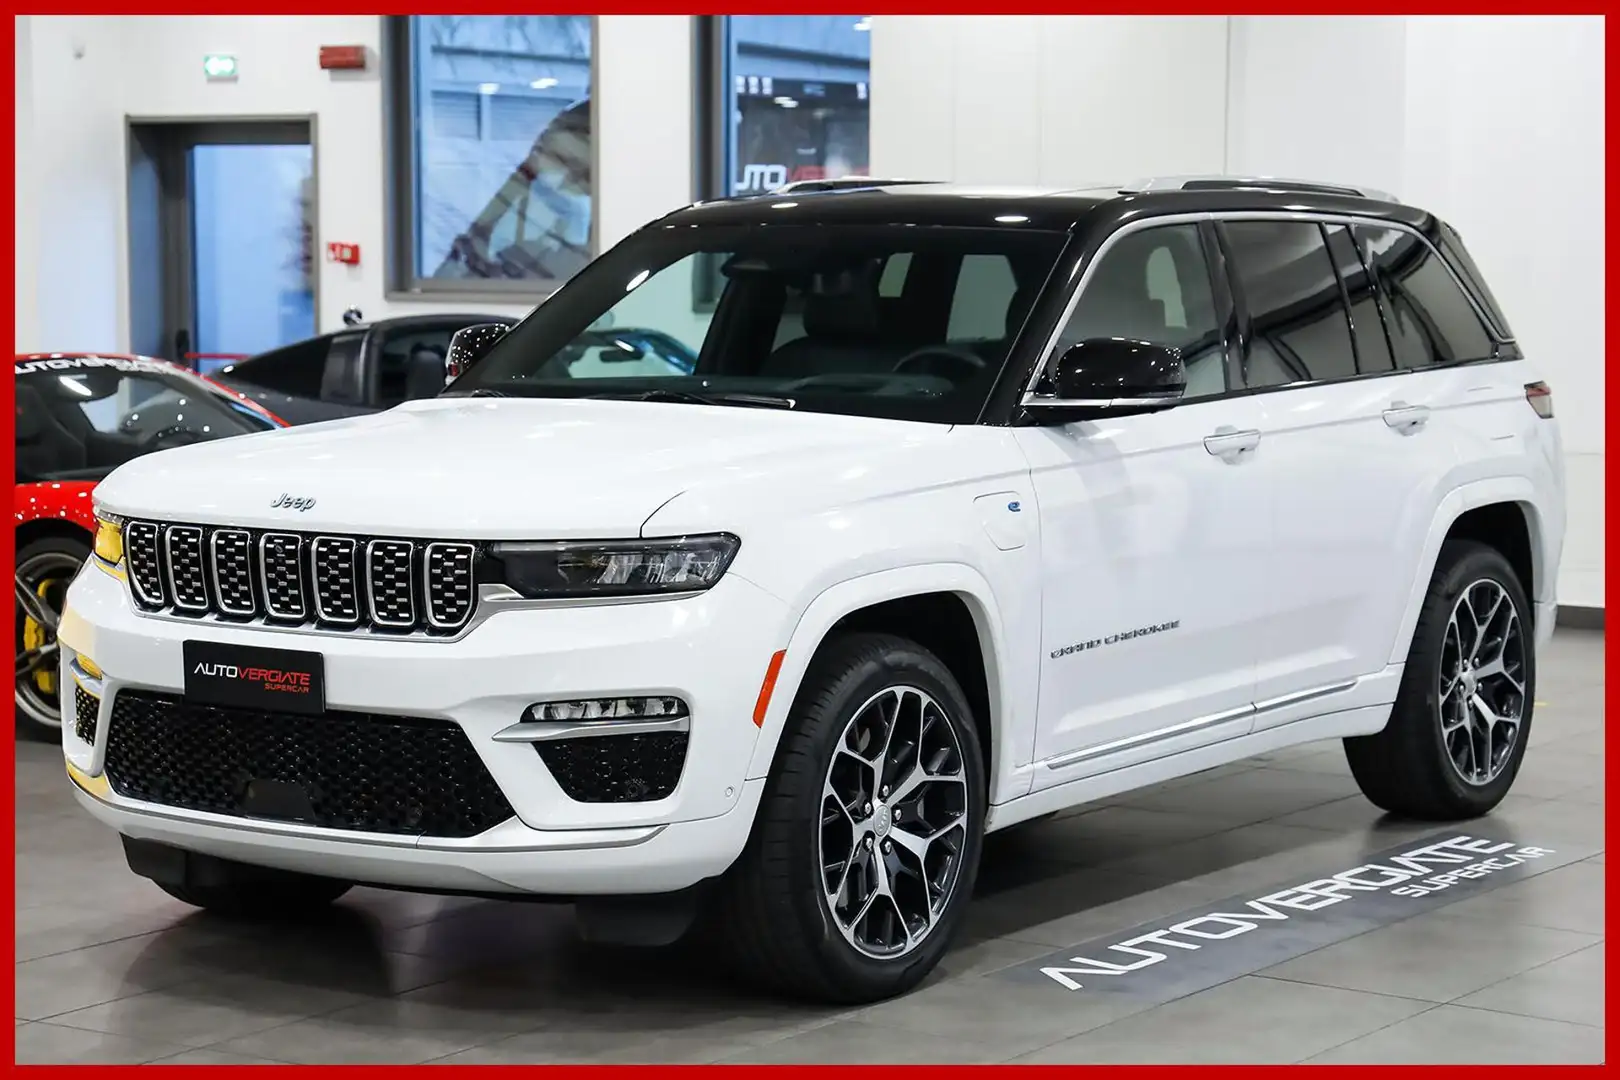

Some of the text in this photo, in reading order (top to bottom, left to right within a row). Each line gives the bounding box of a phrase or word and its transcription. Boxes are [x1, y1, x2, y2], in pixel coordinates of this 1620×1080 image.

[270, 492, 317, 512] Jeep
[1050, 619, 1181, 659] GRAND CHEROKEE
[194, 662, 311, 685] AUTOVERGIATE
[264, 682, 310, 693] SUPERCAR
[1391, 846, 1556, 898] SUPERCAR
[1039, 835, 1516, 991] AUTOVERGIATE
